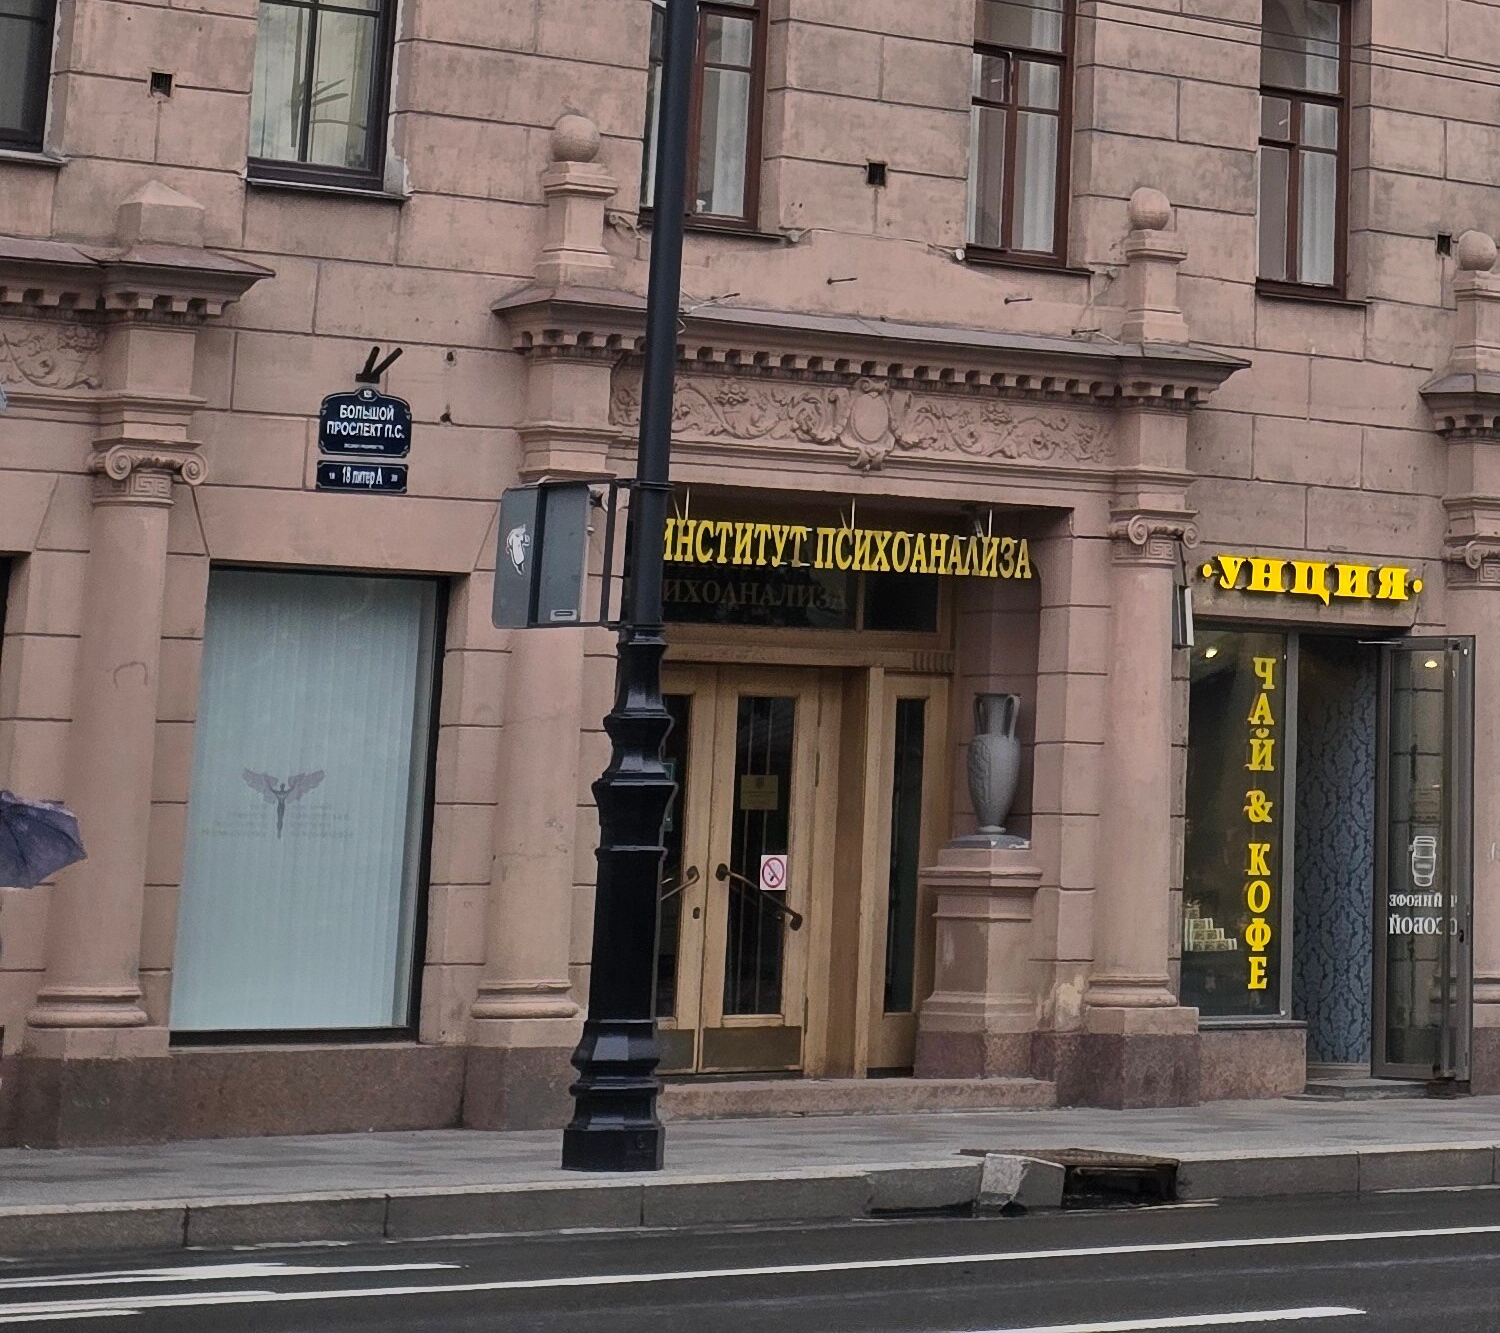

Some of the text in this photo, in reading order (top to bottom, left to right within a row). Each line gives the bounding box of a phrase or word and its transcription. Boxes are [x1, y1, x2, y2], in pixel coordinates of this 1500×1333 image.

[326, 420, 406, 439] ПРОСПЕКТ П.С.
[339, 404, 395, 421] БОЛЬШОЙ
[342, 466, 352, 484] 18
[351, 470, 376, 489] литер
[375, 467, 383, 485] А
[814, 527, 1032, 579] ПСИХОАНАЛИЗА
[663, 578, 849, 610] ИХОАНАЛИЗА
[1217, 555, 1410, 607] УНЦИЯ
[1249, 657, 1277, 772] ЧАЙ
[1245, 843, 1272, 990] КОФЕ
